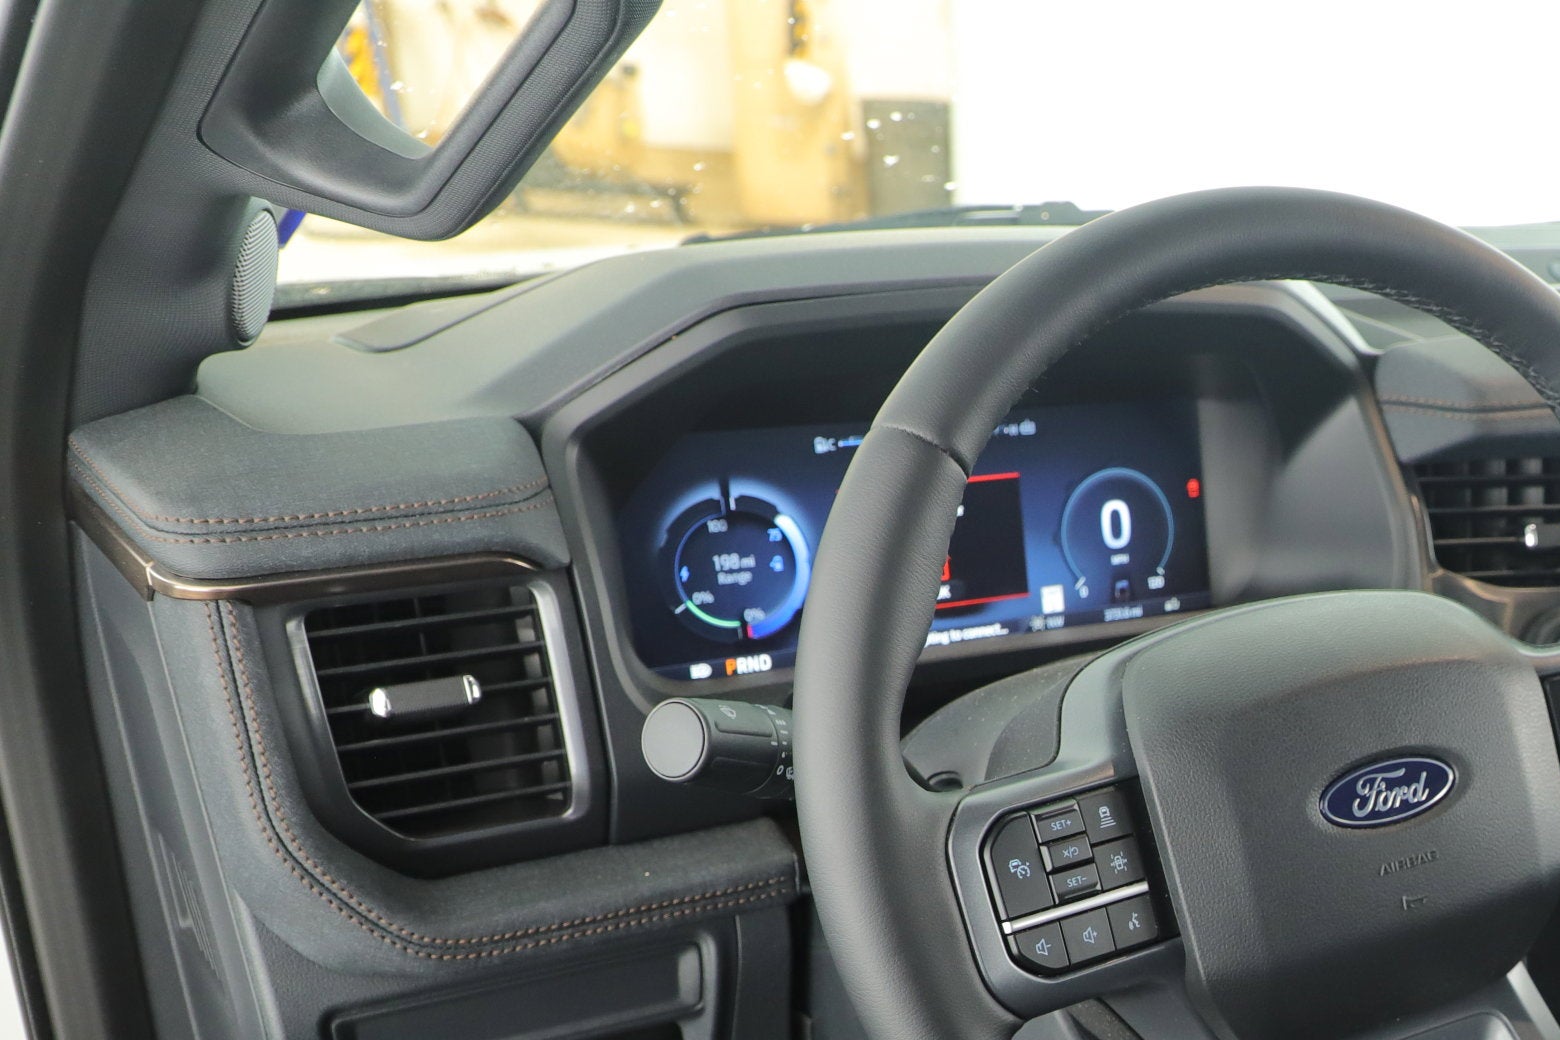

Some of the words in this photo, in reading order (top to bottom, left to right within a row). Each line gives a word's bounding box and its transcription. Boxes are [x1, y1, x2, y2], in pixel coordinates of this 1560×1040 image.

[1101, 499, 1132, 549] 0
[717, 571, 753, 585] Range
[1352, 767, 1430, 818] Ford
[1051, 819, 1072, 831] SET+
